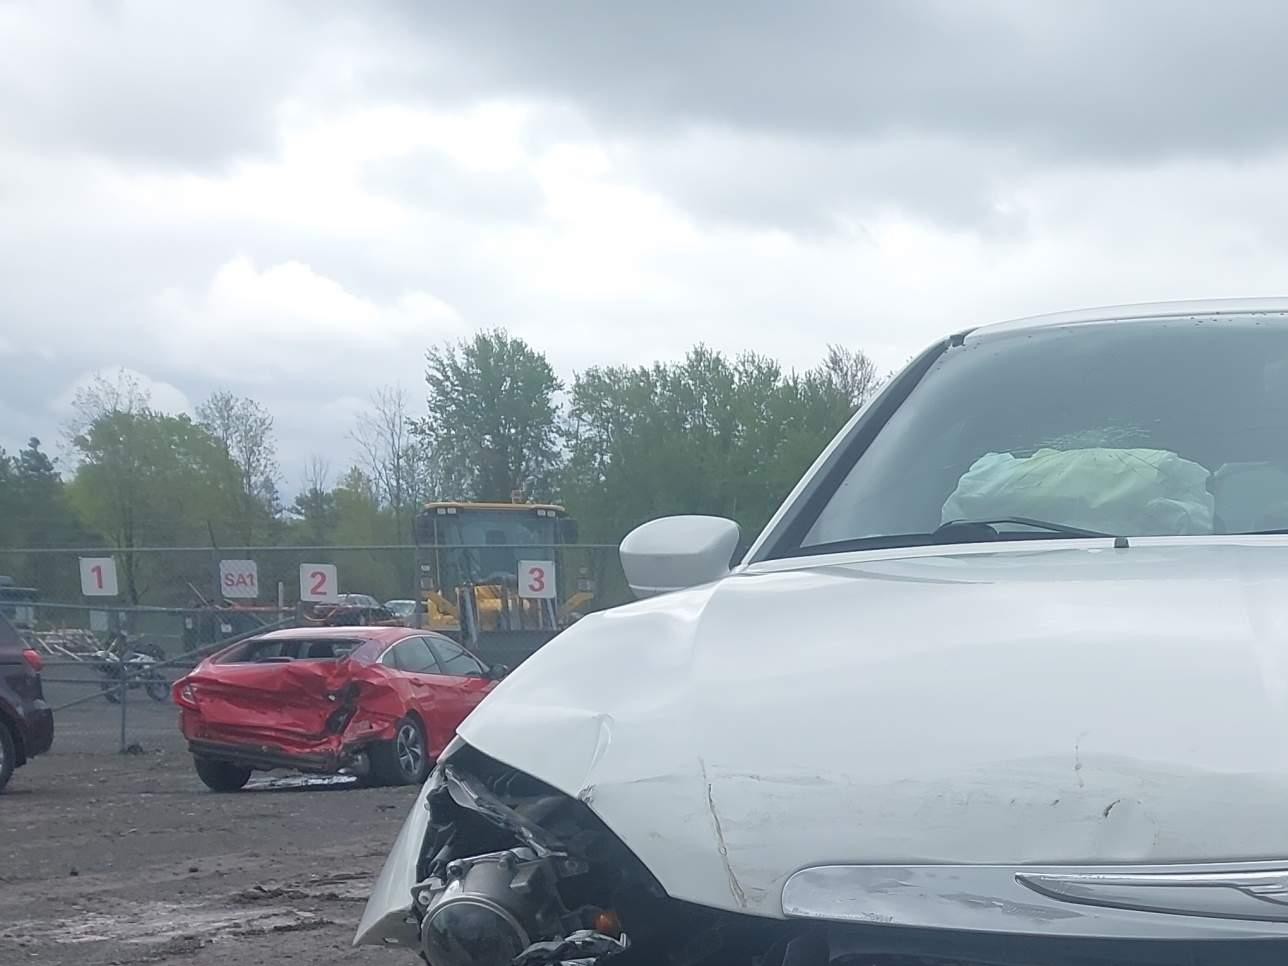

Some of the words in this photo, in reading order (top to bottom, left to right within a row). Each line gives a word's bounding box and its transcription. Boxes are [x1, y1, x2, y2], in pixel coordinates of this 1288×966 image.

[91, 565, 104, 589] 1
[223, 572, 256, 588] SA1
[309, 571, 328, 596] 2
[528, 567, 545, 592] 3
